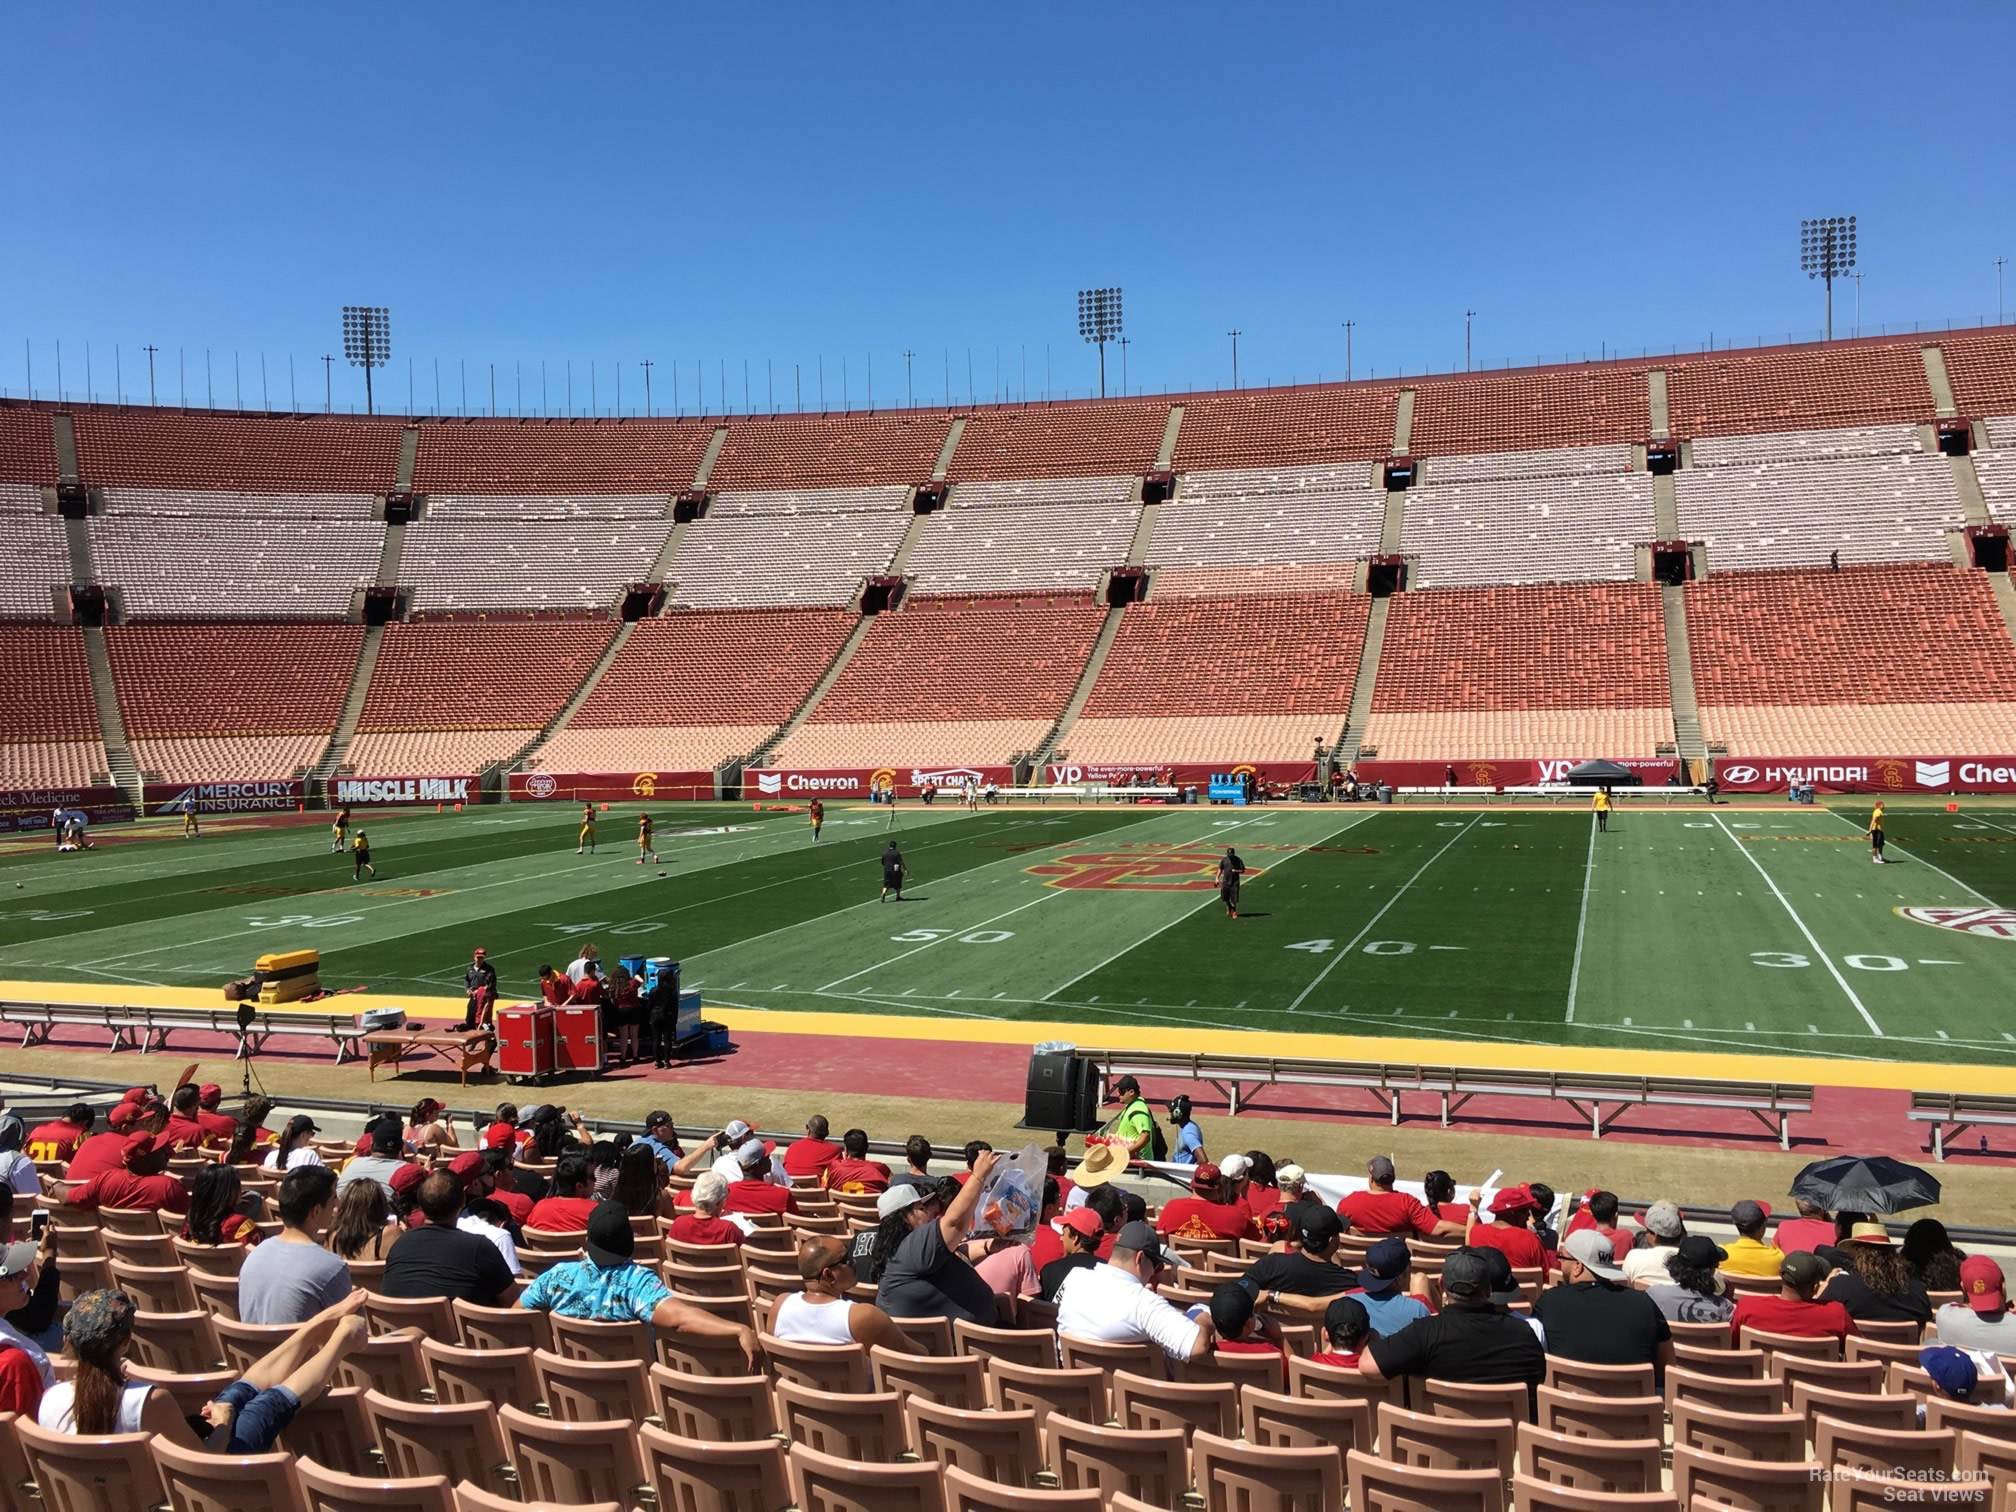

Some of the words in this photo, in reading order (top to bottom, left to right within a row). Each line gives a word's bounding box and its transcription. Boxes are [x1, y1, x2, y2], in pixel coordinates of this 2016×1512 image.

[787, 774, 859, 790] Chevron
[1052, 766, 1082, 785] yp
[1765, 767, 1867, 782] HYUNDAI
[21, 791, 80, 805] Medicine
[200, 782, 294, 798] MERCURY
[337, 780, 416, 802] MUSCLE
[419, 778, 468, 800] MILK
[200, 798, 295, 811] INSURANCE
[29, 1141, 58, 1161] 21
